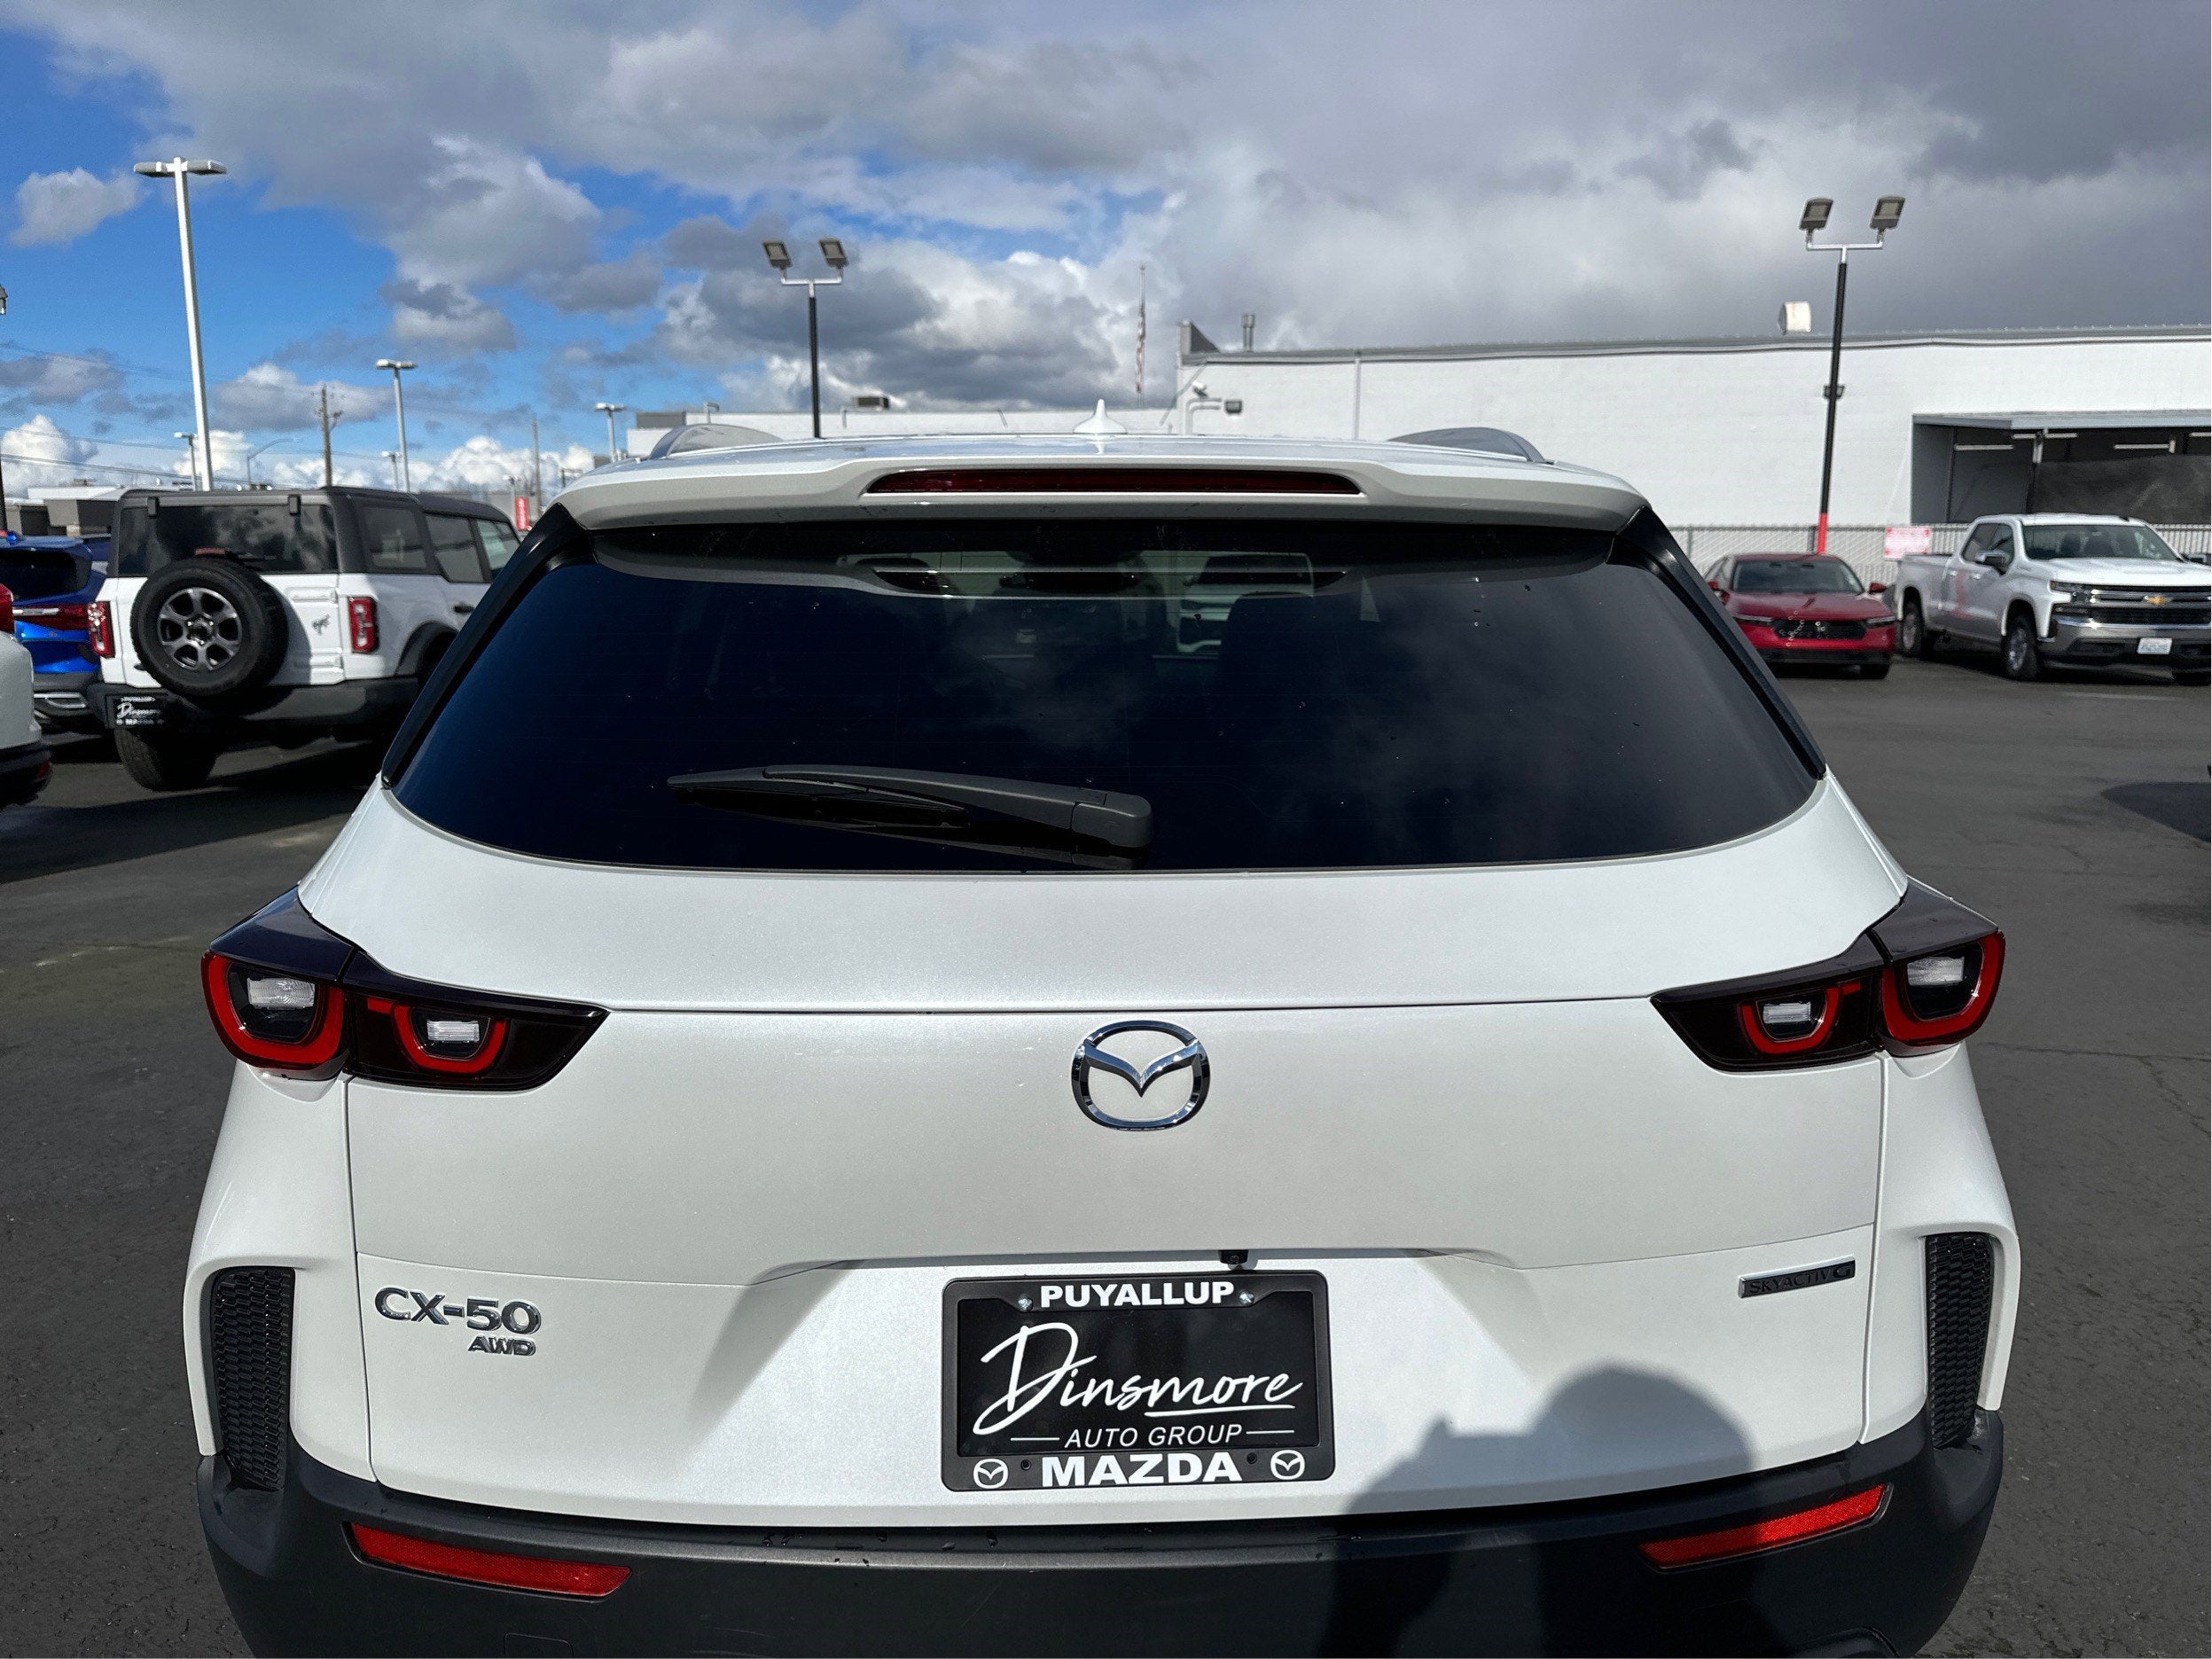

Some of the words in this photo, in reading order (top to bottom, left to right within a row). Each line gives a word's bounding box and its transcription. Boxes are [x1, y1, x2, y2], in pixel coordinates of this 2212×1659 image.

[1041, 1282, 1234, 1308] PUYALLUP
[1749, 1269, 1832, 1295] SKYACTIV
[1833, 1264, 1852, 1279] G
[374, 1287, 543, 1335] CX-50
[468, 1336, 537, 1357] AWD
[973, 1322, 1304, 1436] Dinsmore
[1065, 1428, 1138, 1449] AUTO
[1148, 1425, 1243, 1446] GROUP
[1042, 1452, 1243, 1488] MAZDA
